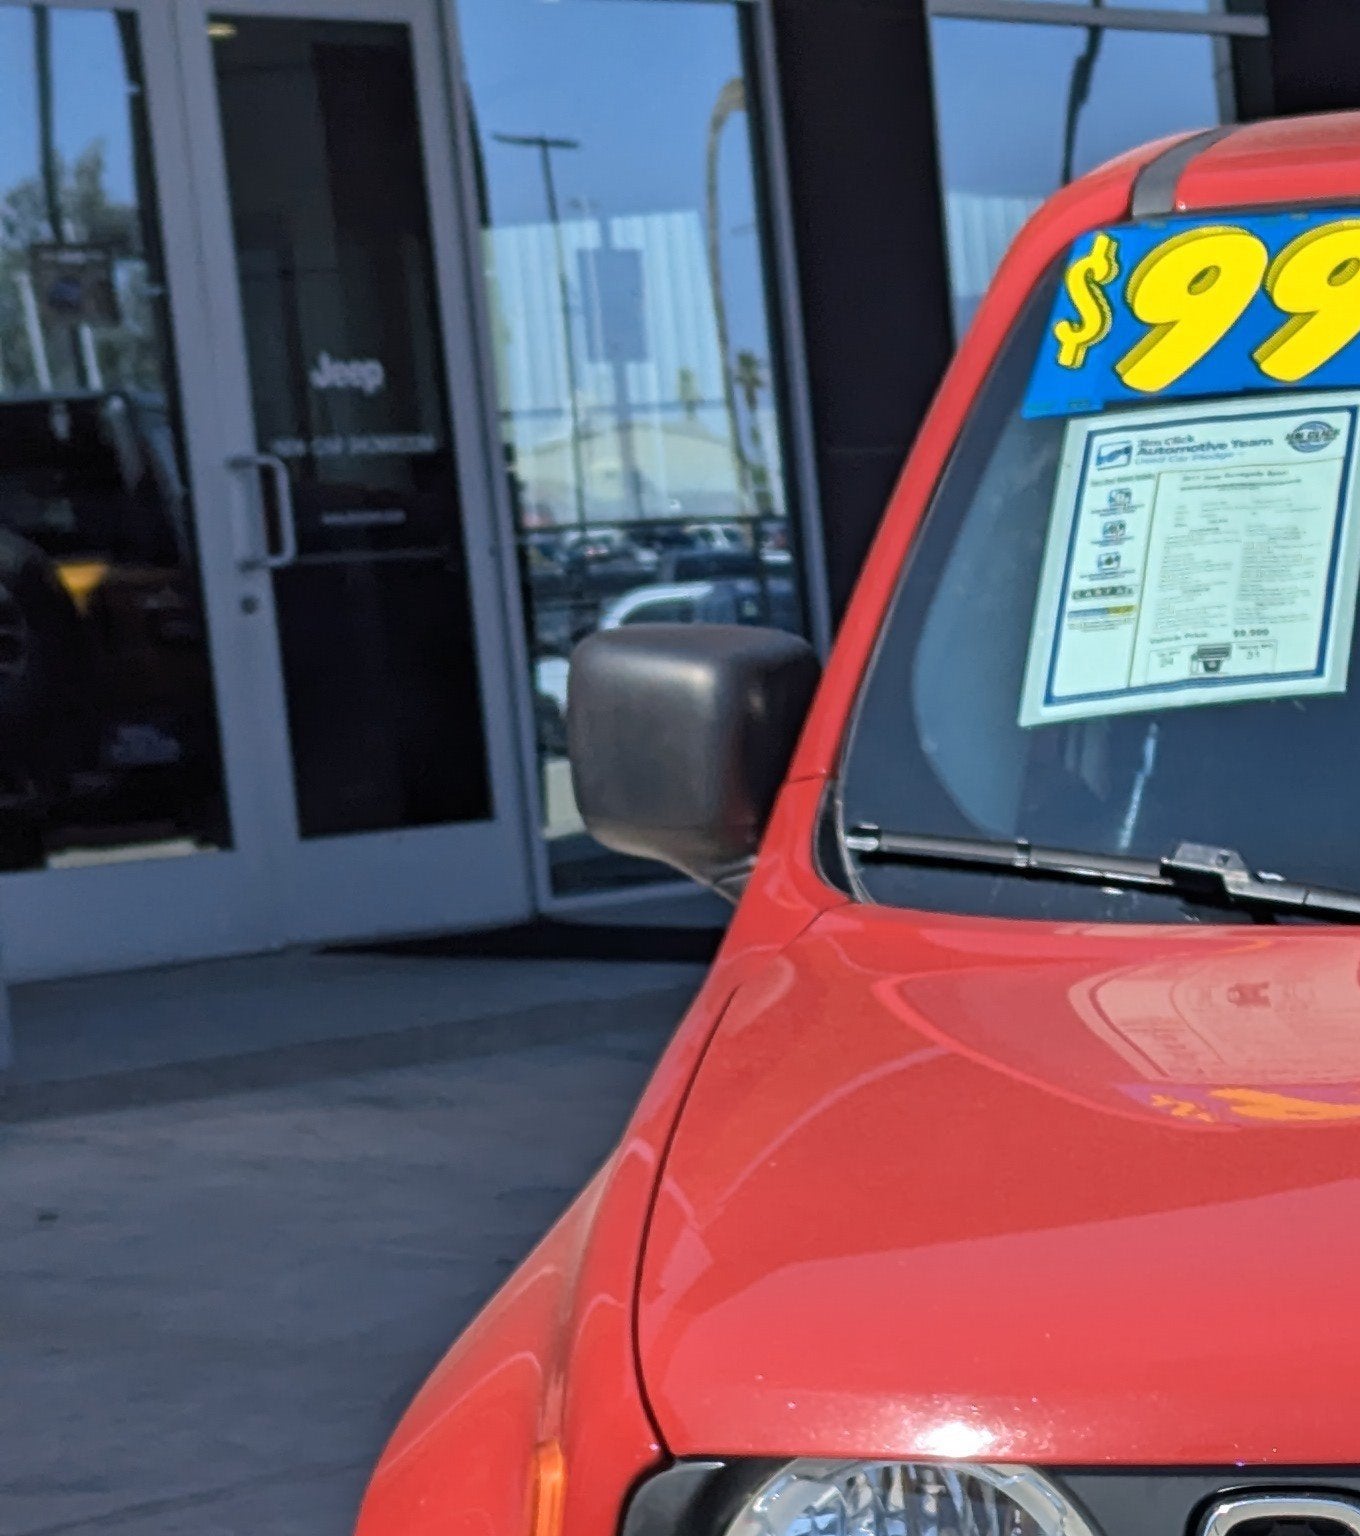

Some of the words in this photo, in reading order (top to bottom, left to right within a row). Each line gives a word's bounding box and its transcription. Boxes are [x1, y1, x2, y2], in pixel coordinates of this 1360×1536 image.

[309, 351, 386, 394] Jeep
[1138, 441, 1228, 455] Automotive
[1231, 438, 1274, 449] Team
